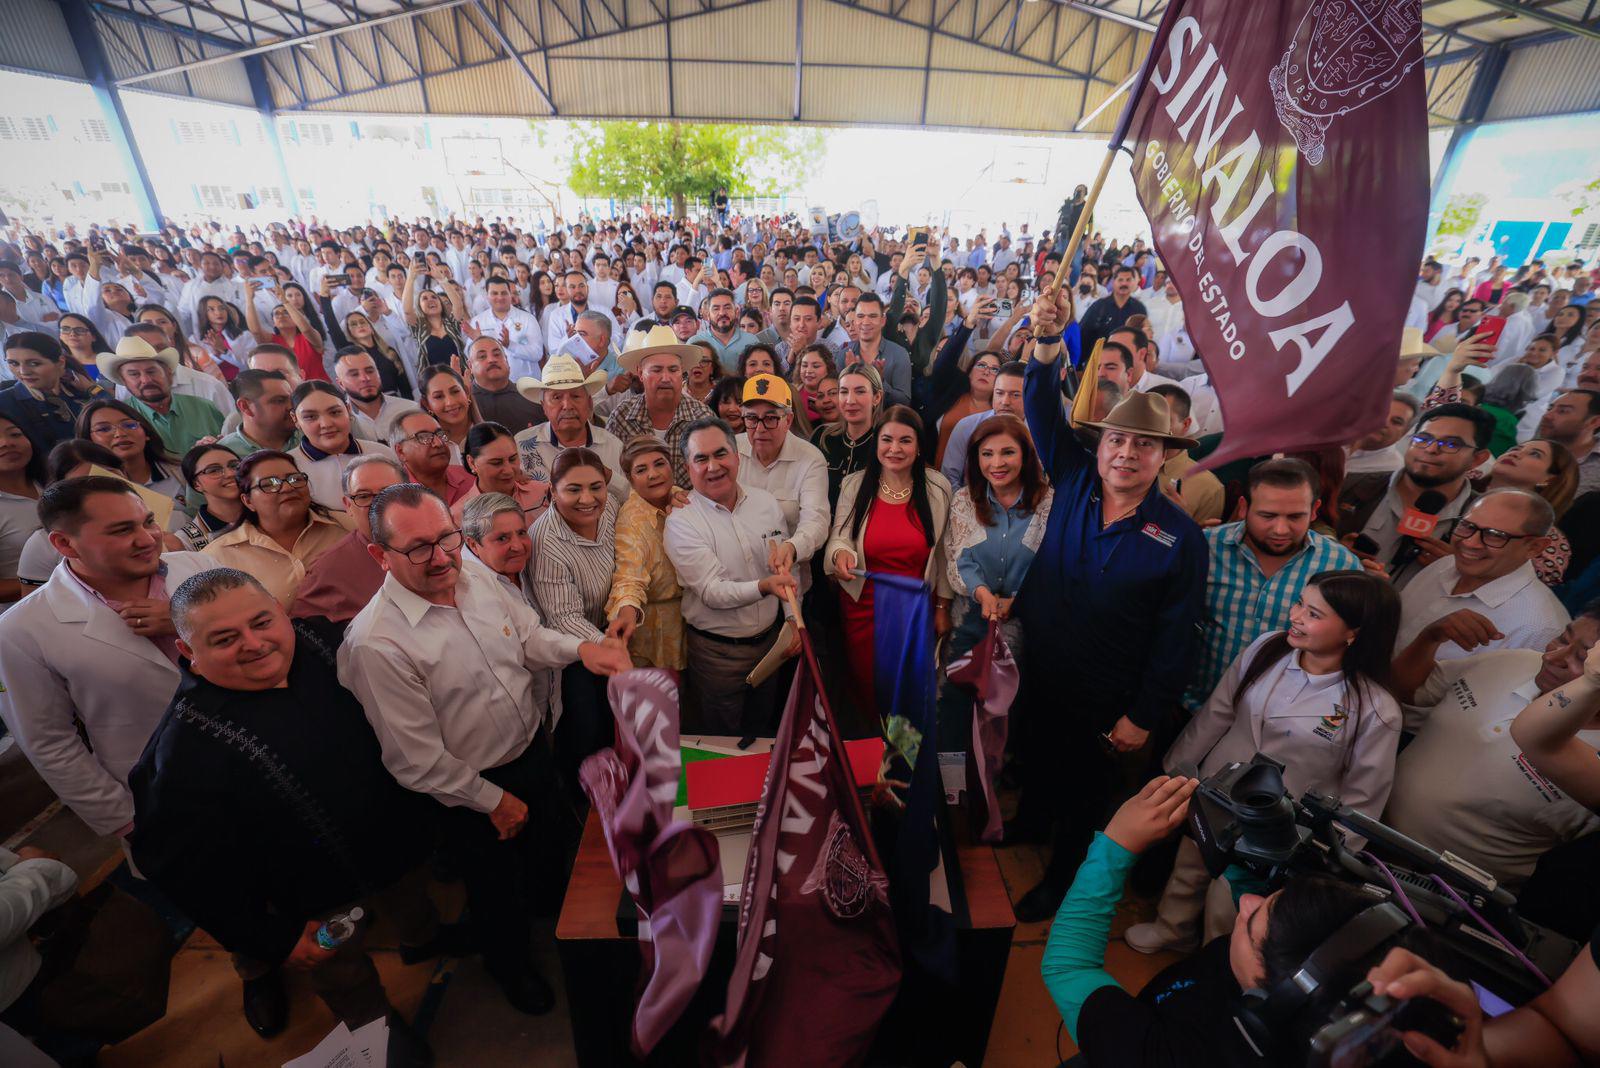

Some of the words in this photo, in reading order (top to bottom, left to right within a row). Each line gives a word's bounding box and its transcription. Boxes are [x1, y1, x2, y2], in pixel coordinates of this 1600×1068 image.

[1144, 139, 1196, 233] GOBIERNO
[1188, 232, 1206, 276] DEL
[1198, 271, 1246, 361] ESTADO
[1150, 16, 1356, 397] SINALOA
